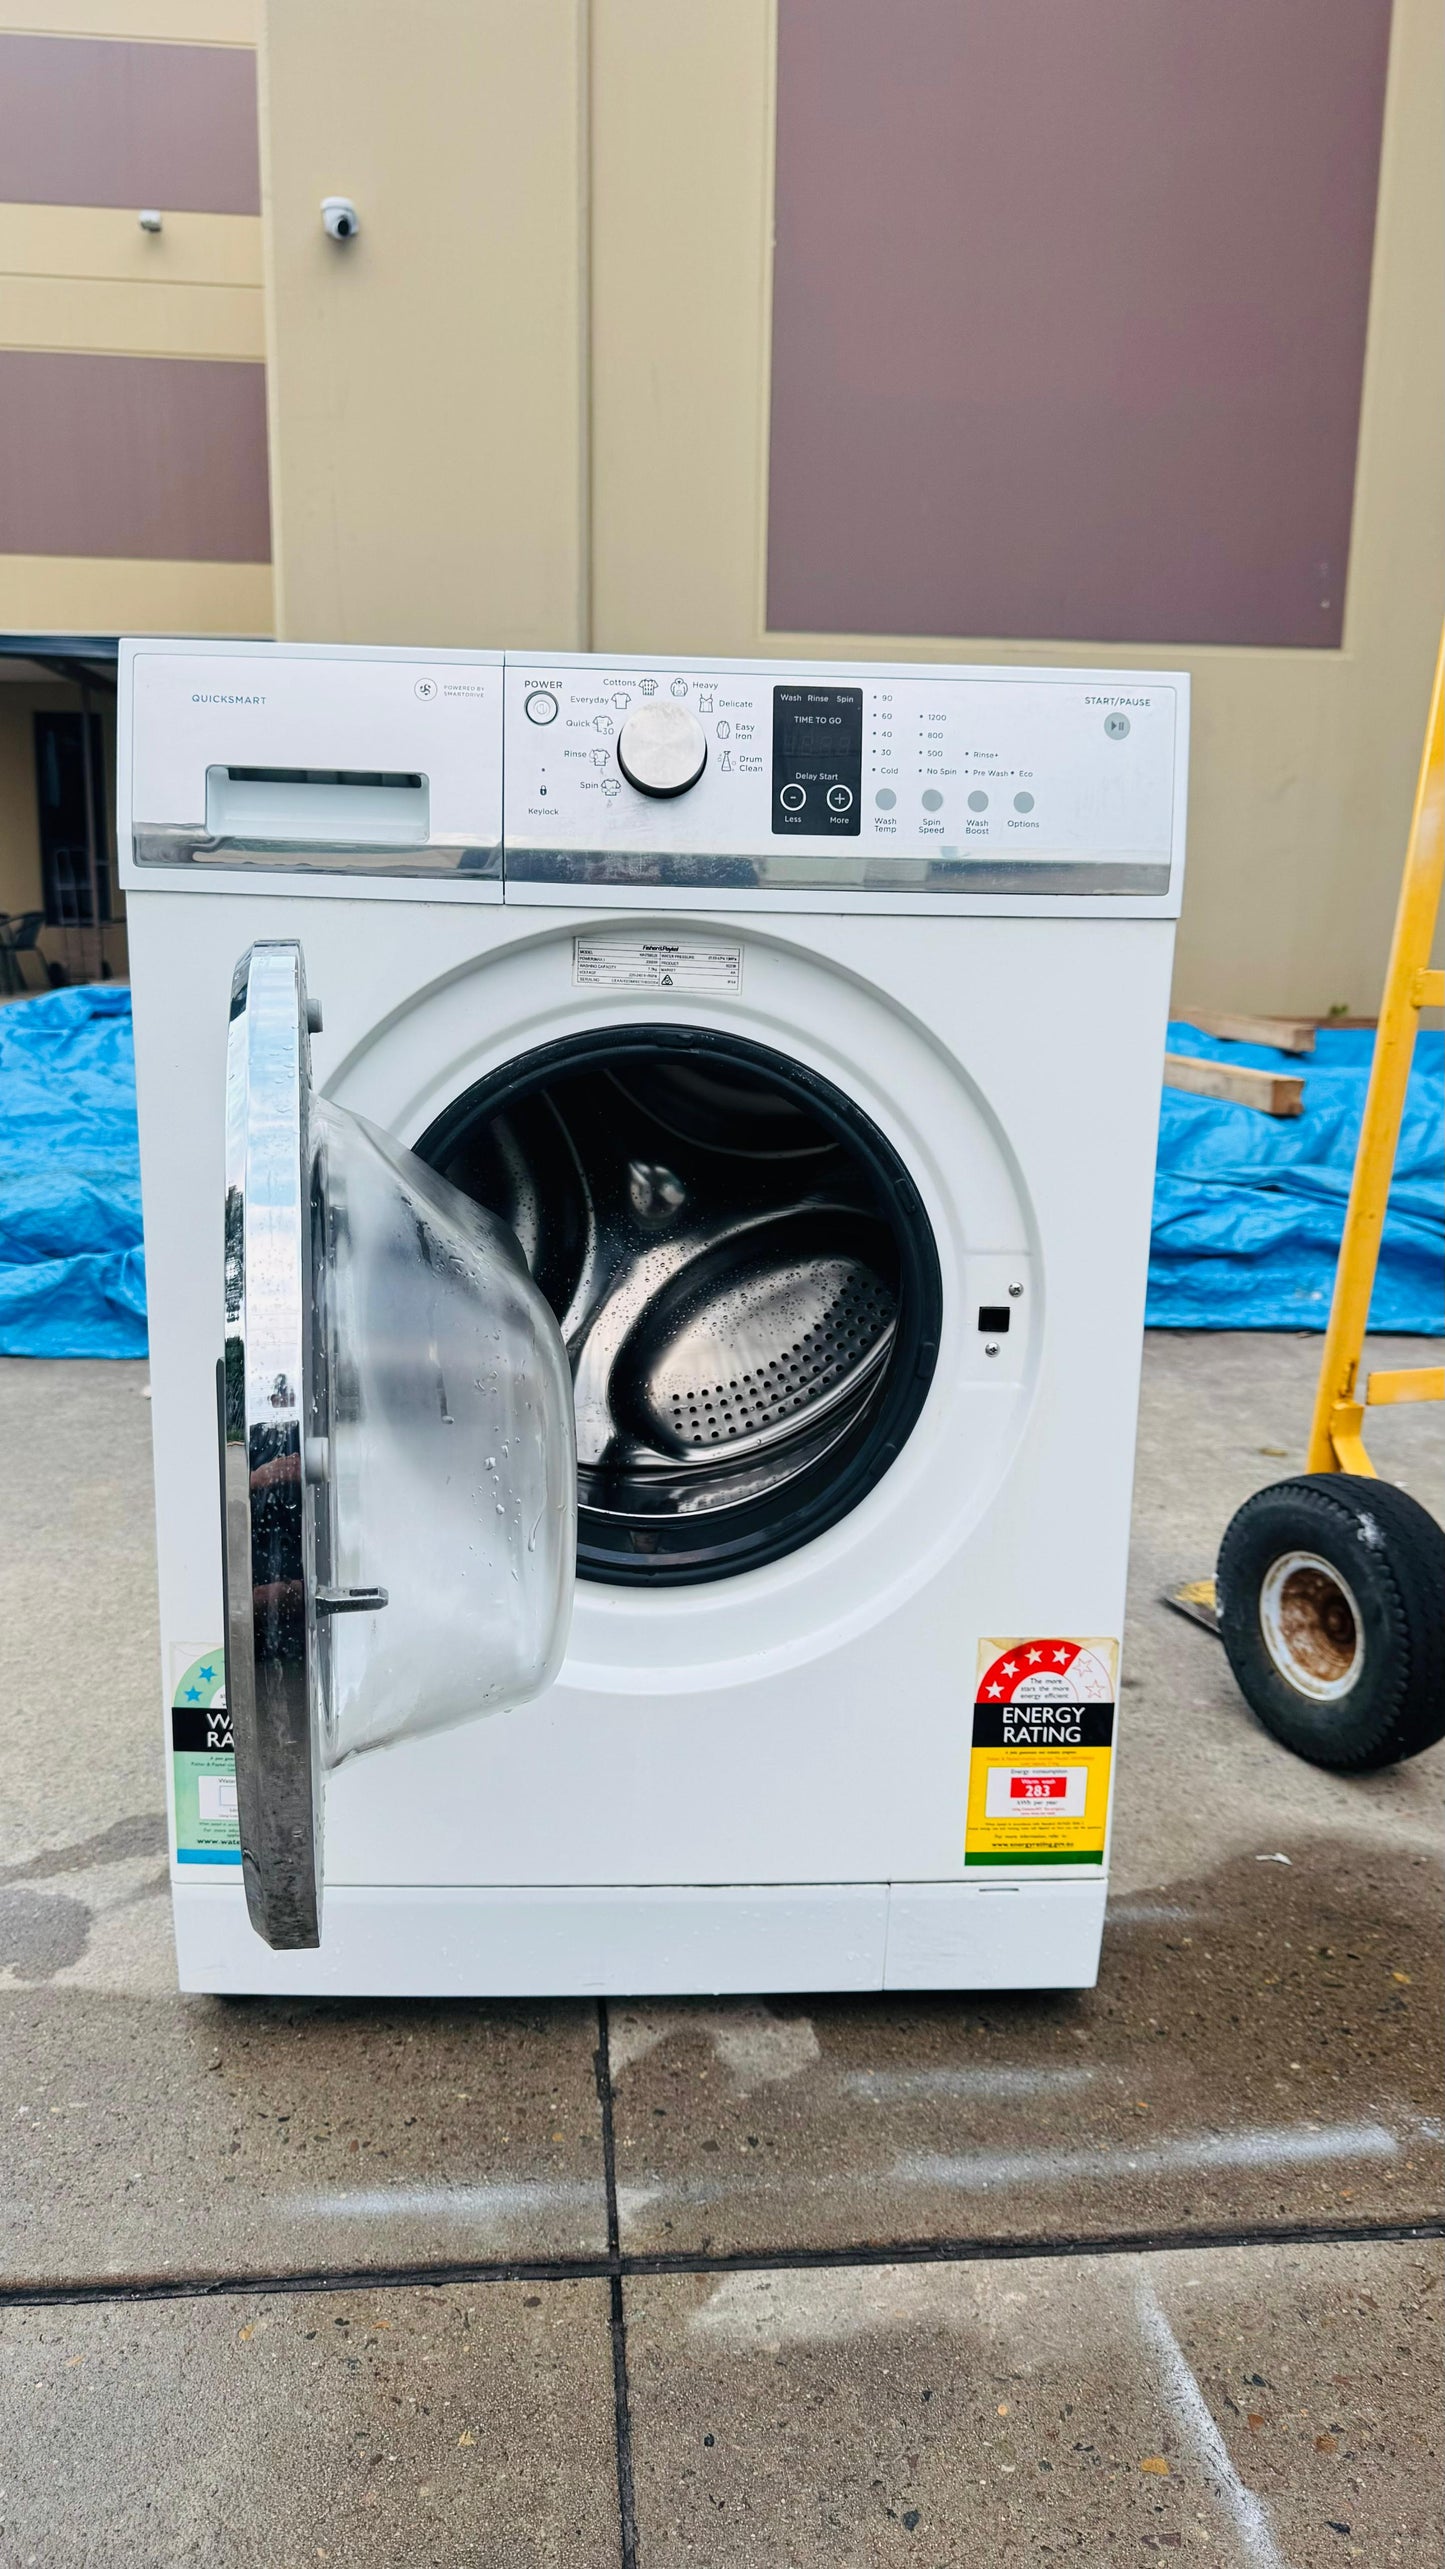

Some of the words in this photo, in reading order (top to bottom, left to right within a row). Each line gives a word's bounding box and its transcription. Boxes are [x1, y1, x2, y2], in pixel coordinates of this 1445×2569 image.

[525, 680, 563, 689] POWER
[603, 679, 636, 687] Cottons
[693, 681, 718, 690] Heavy
[192, 694, 267, 705] QUICKSMART
[570, 696, 609, 705] Everyday
[781, 694, 802, 702] Wash
[808, 694, 828, 703] Rinse
[836, 695, 854, 704] Spin
[1084, 697, 1151, 707] START/PAUSE
[719, 700, 753, 708] Delicate
[566, 720, 590, 728] Quick
[794, 716, 814, 724] TIME
[603, 727, 614, 735] 30
[736, 723, 755, 732] Easy
[564, 750, 586, 758] Rinse
[973, 751, 999, 759] Rinse+
[881, 767, 898, 775] Cold
[939, 768, 957, 777] Spin
[795, 772, 817, 782] Delay
[819, 773, 838, 781] Start
[580, 782, 598, 790] Spin
[528, 808, 559, 816] Keylock
[785, 815, 802, 824] Less
[830, 816, 849, 824] More
[923, 819, 940, 827] Spin
[966, 819, 988, 827] Wash
[1007, 820, 1040, 829] Options
[875, 826, 896, 834] Temp
[918, 826, 944, 835] Speed
[965, 827, 989, 835] Boost
[1002, 1707, 1085, 1723] ENERGY
[1003, 1727, 1081, 1743] RATING
[1025, 1786, 1050, 1797] 283
